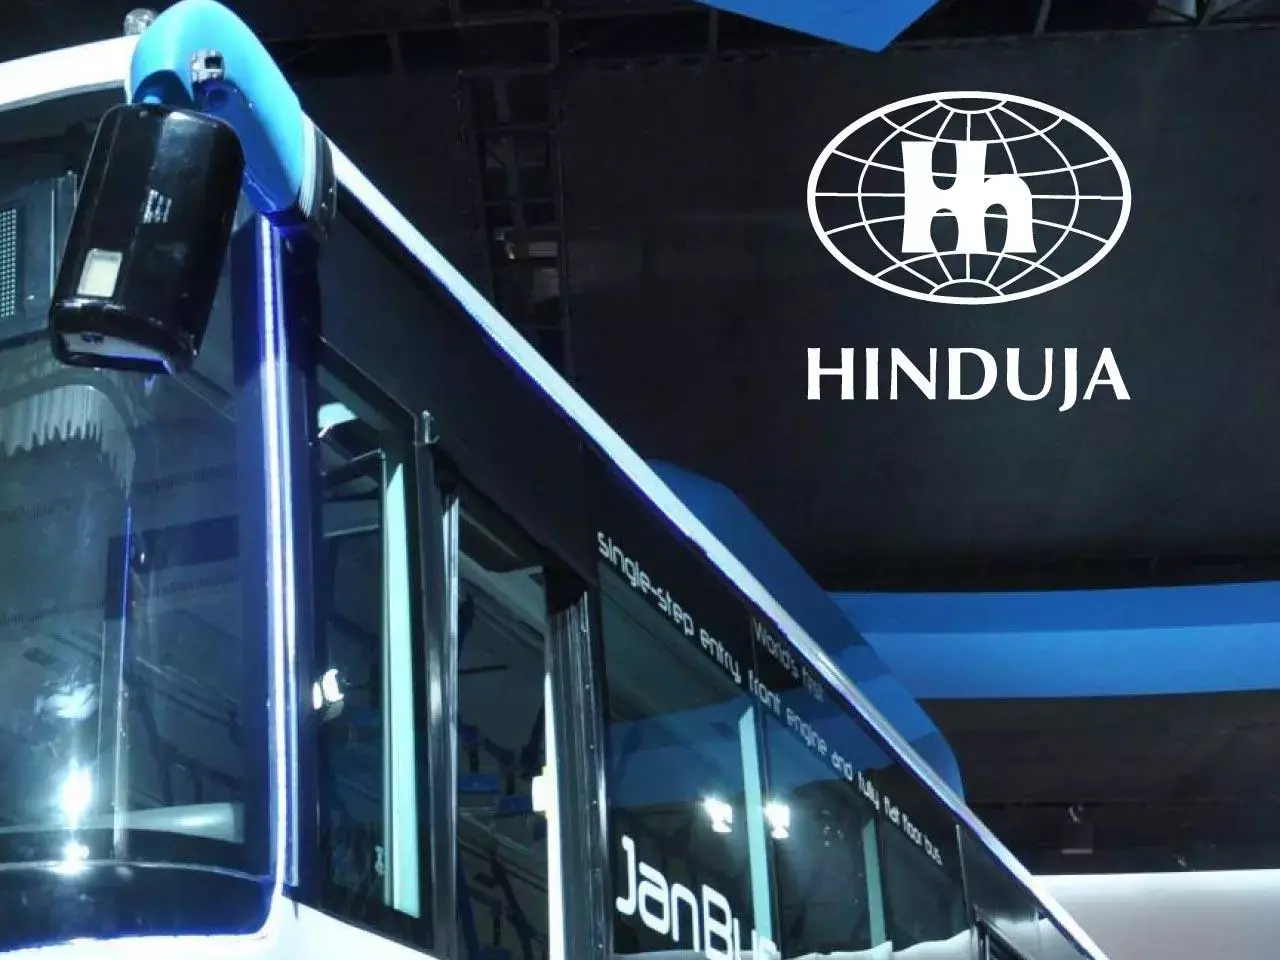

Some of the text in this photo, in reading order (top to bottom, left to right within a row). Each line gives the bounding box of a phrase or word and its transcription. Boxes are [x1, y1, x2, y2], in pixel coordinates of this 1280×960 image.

[597, 531, 695, 636] single-step
[699, 627, 742, 684] entry
[747, 669, 782, 717] front
[786, 707, 828, 756] engine
[830, 751, 853, 783] and
[857, 770, 880, 811] fully
